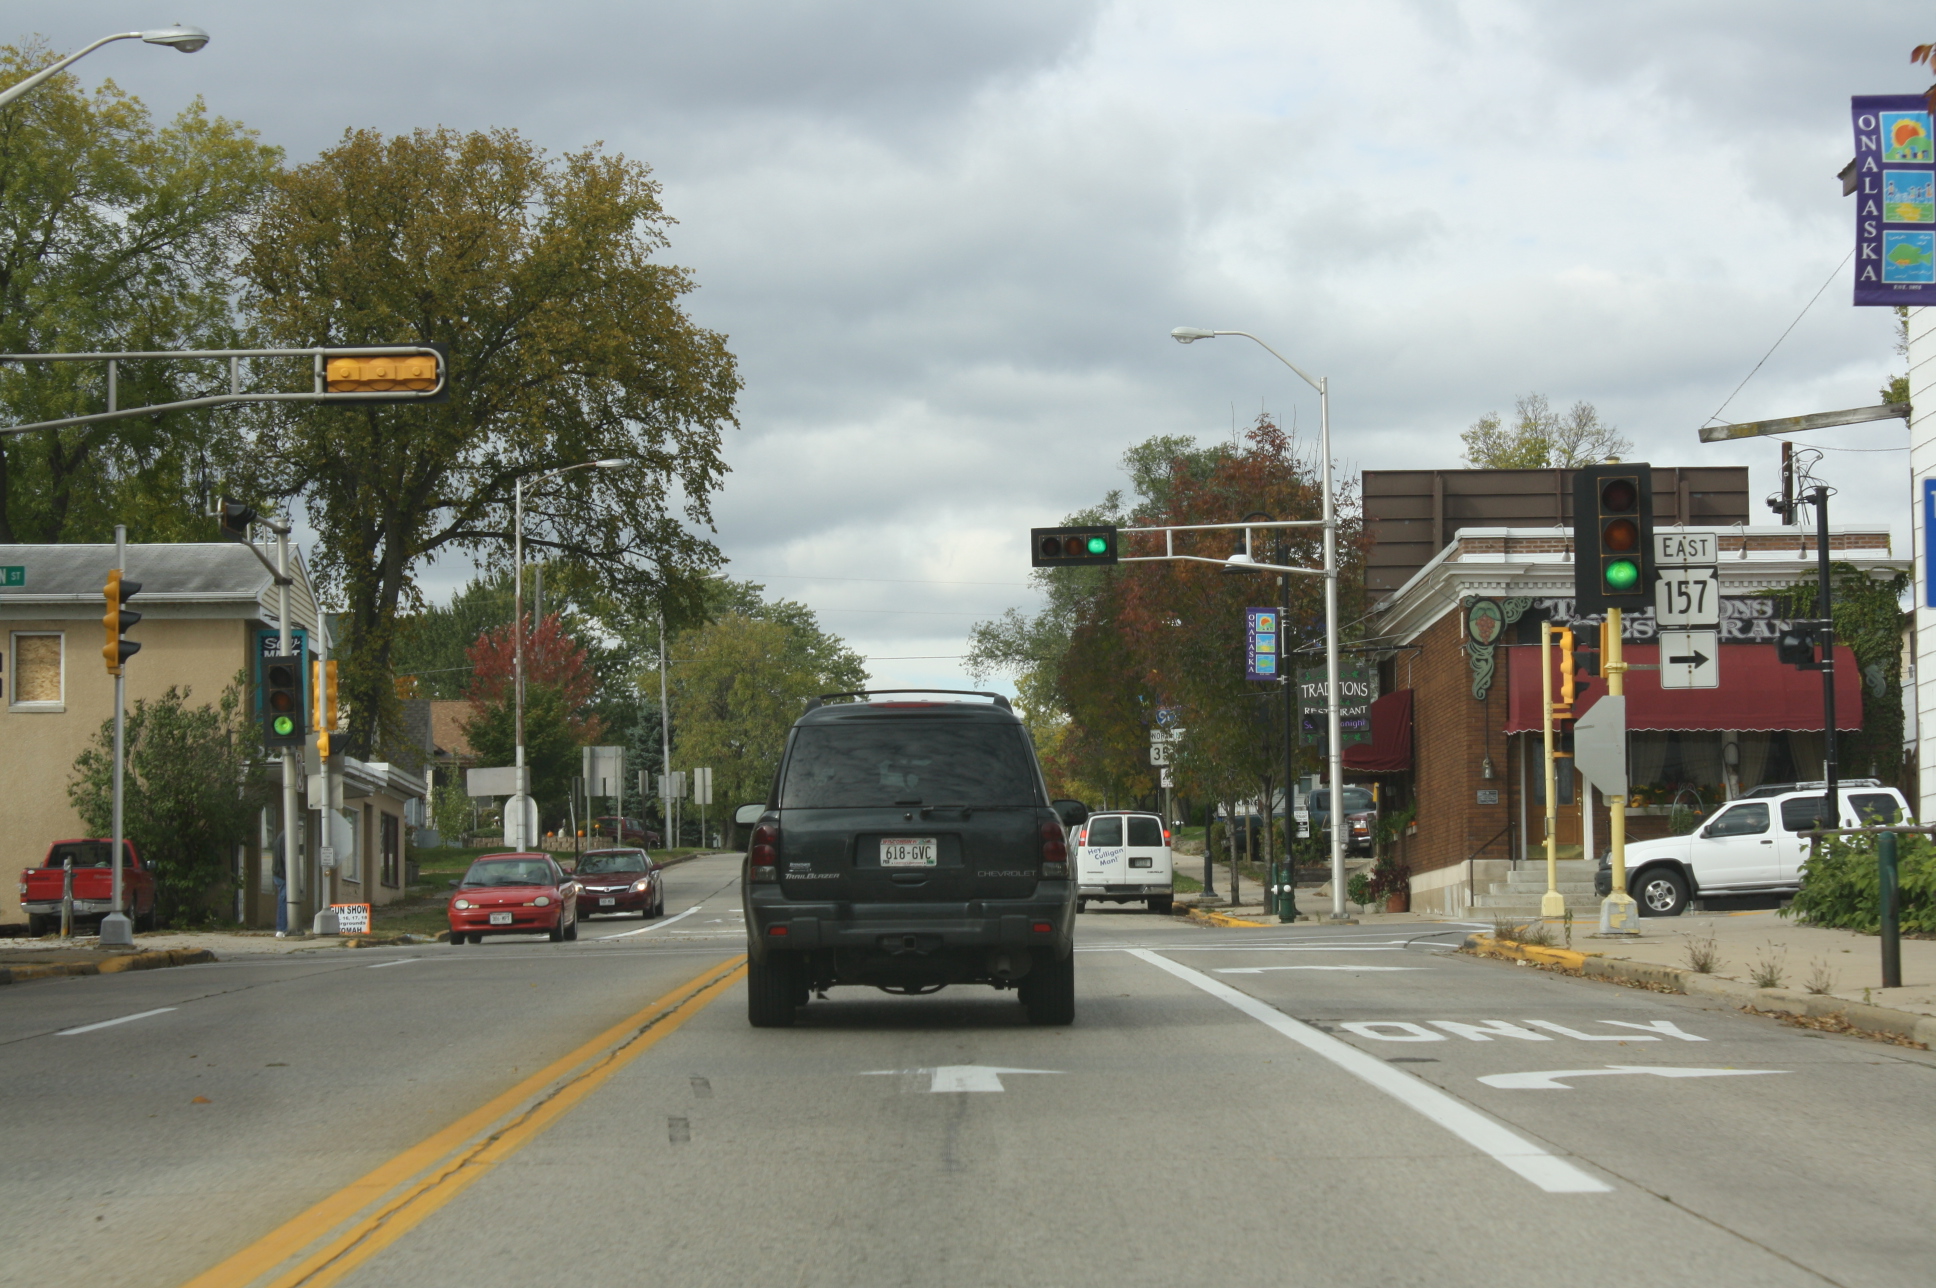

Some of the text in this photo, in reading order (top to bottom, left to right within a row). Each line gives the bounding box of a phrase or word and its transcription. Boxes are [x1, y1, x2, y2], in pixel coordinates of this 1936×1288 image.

[1858, 114, 1879, 281] ONALASKA
[1663, 537, 1708, 557] EAST
[11, 572, 20, 580] ST
[1664, 580, 1708, 614] 157
[1301, 681, 1368, 698] TRADIONS
[886, 846, 931, 860] 618-GVC
[1095, 848, 1123, 860] Culligan
[347, 905, 367, 914] SHOW
[1340, 1020, 1711, 1041] ONLY
